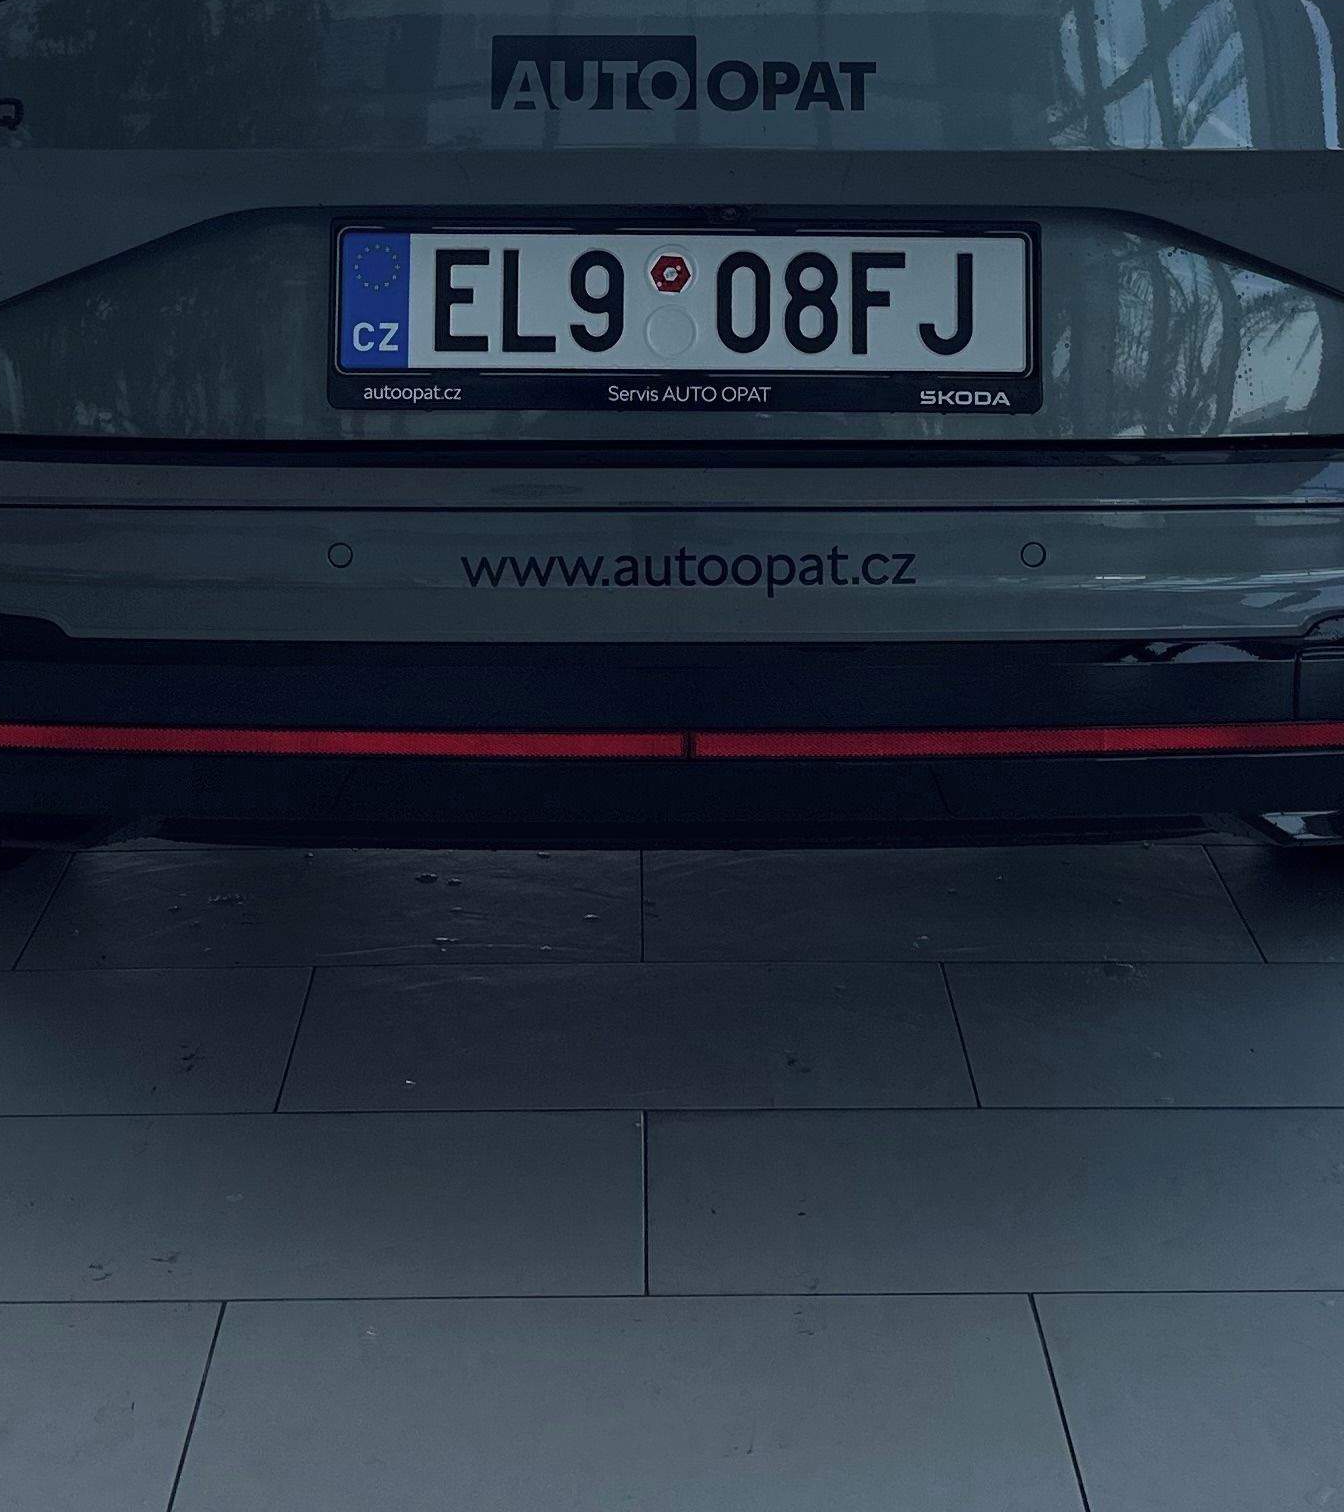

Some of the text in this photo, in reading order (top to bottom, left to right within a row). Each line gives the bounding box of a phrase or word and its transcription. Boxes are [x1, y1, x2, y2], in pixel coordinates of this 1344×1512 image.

[434, 249, 974, 355] EL9 08FJ
[352, 322, 400, 353] CZ
[363, 384, 462, 403] autoopat.cz
[607, 385, 772, 402] Servis AUTO OPAT
[461, 546, 917, 598] www.autoopat.cz
